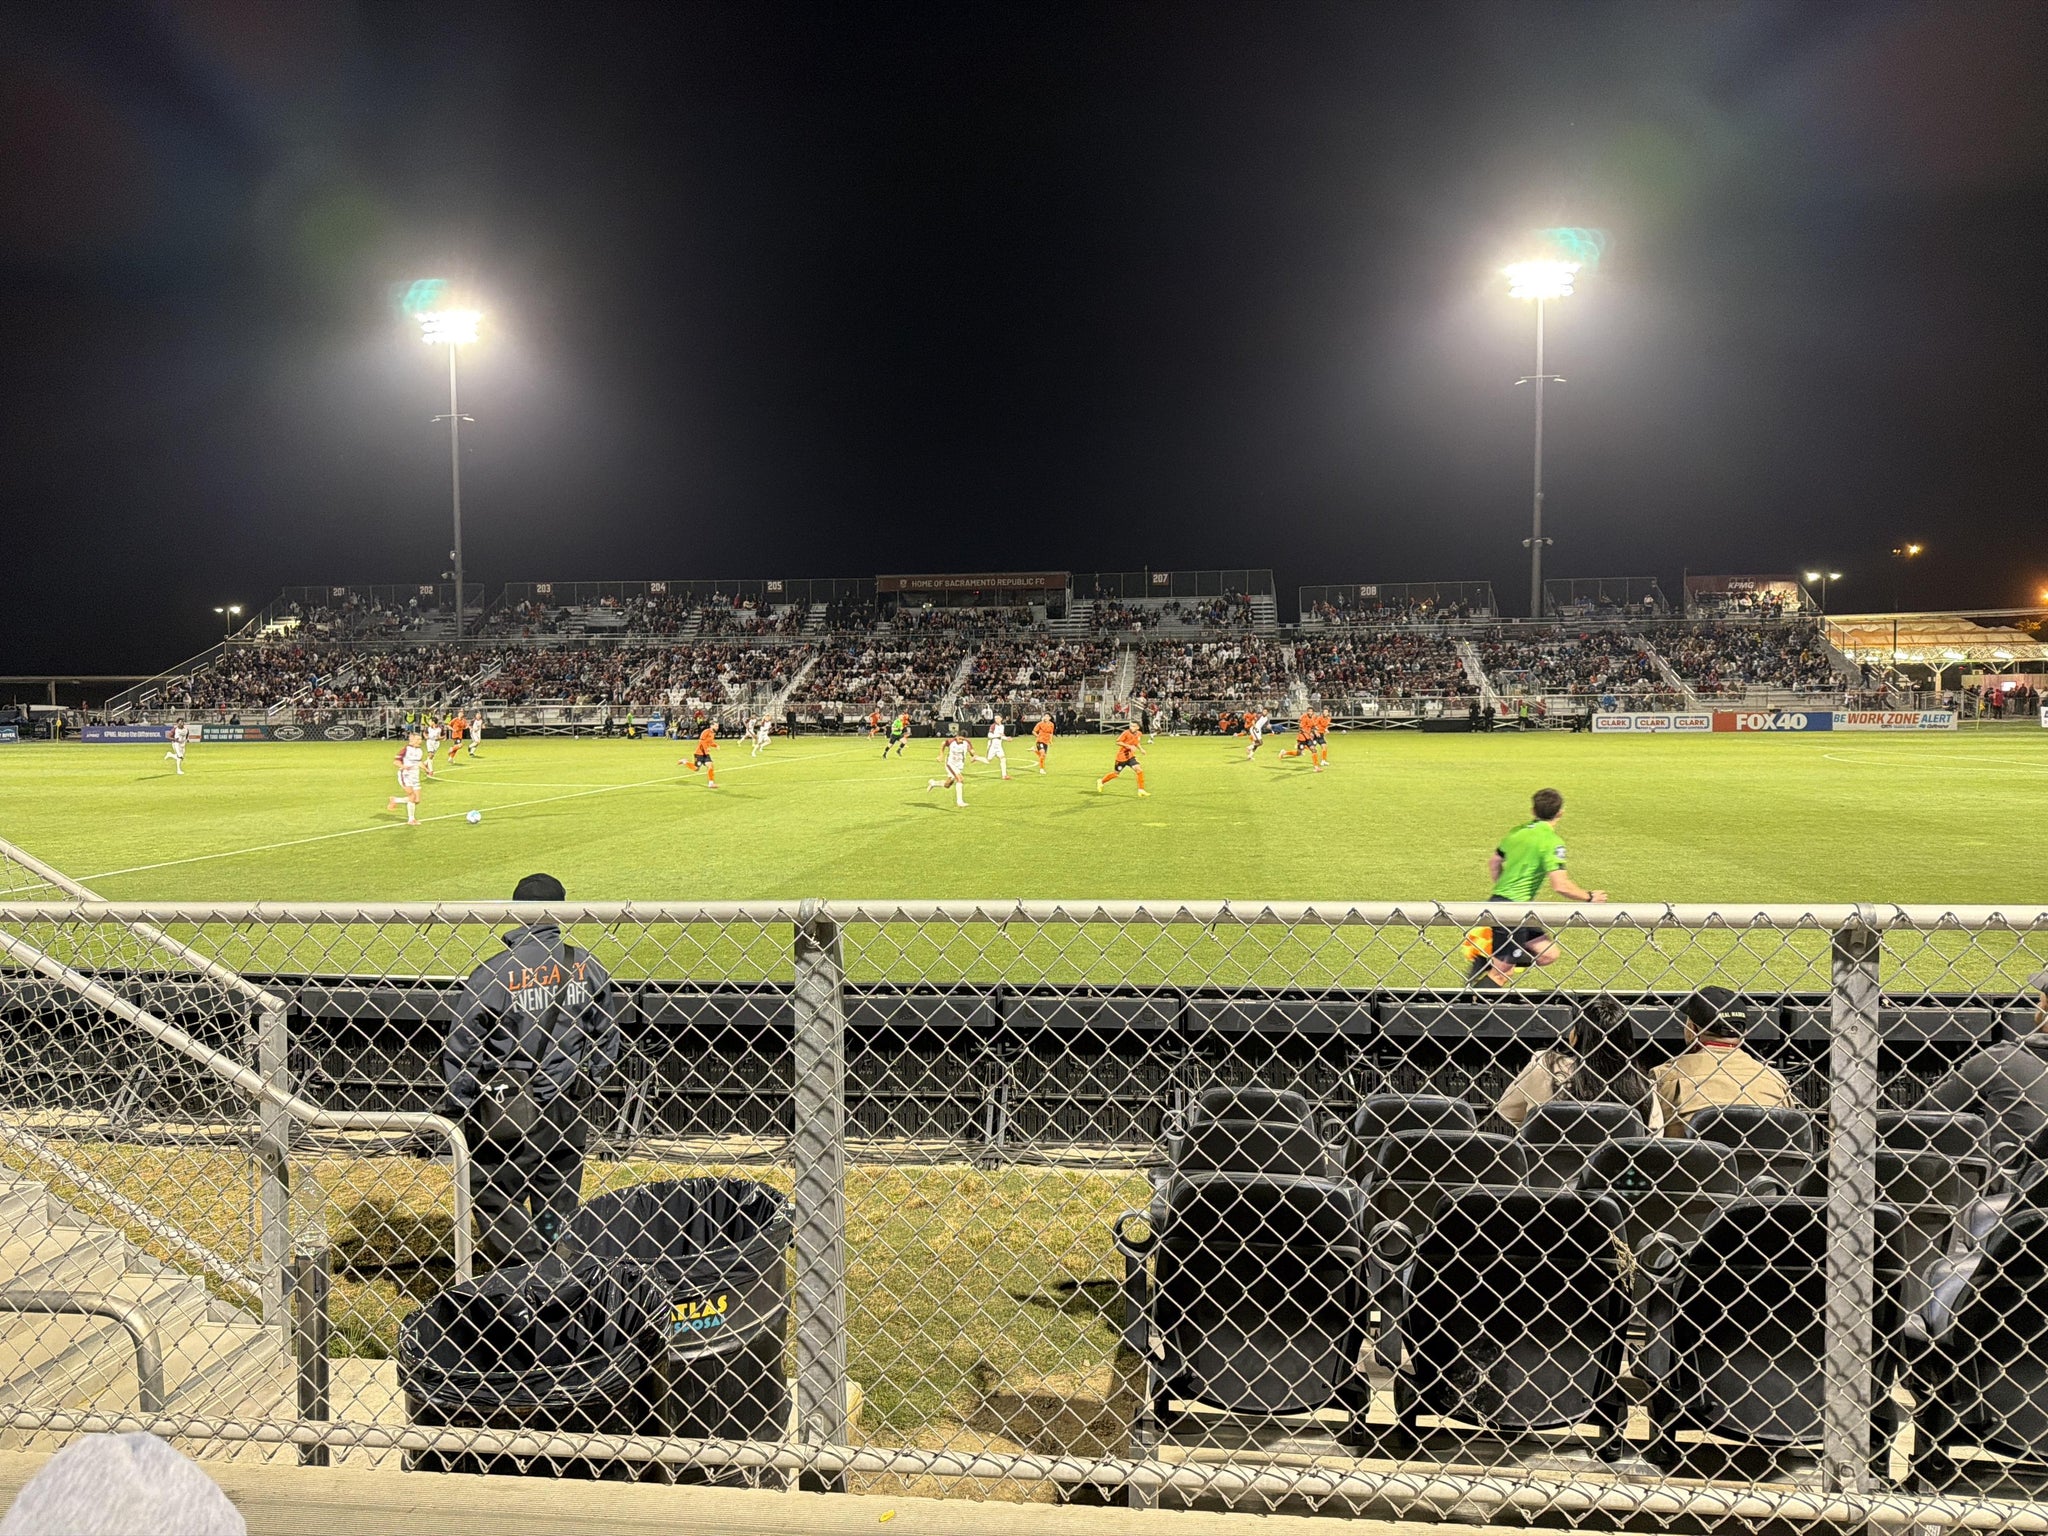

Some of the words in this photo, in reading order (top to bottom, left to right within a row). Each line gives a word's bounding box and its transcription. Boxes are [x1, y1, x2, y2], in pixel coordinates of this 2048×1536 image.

[911, 580, 933, 588] HOME
[944, 578, 996, 587] SACRAMENTO
[997, 577, 1033, 586] REPUBLIC
[1035, 577, 1045, 585] FC
[1152, 573, 1168, 583] 207
[420, 585, 434, 595] 202
[536, 583, 551, 593] 203
[650, 582, 666, 592] 204
[767, 580, 782, 591] 205
[1728, 581, 1755, 589] KPMG
[332, 587, 345, 597] 201
[1736, 713, 1808, 731] FOX40
[1833, 714, 1847, 723] BE
[1847, 713, 1885, 724] WORK
[1886, 713, 1921, 724] ZONE
[1921, 714, 1953, 723] ALERT
[507, 962, 587, 991] LEGAY
